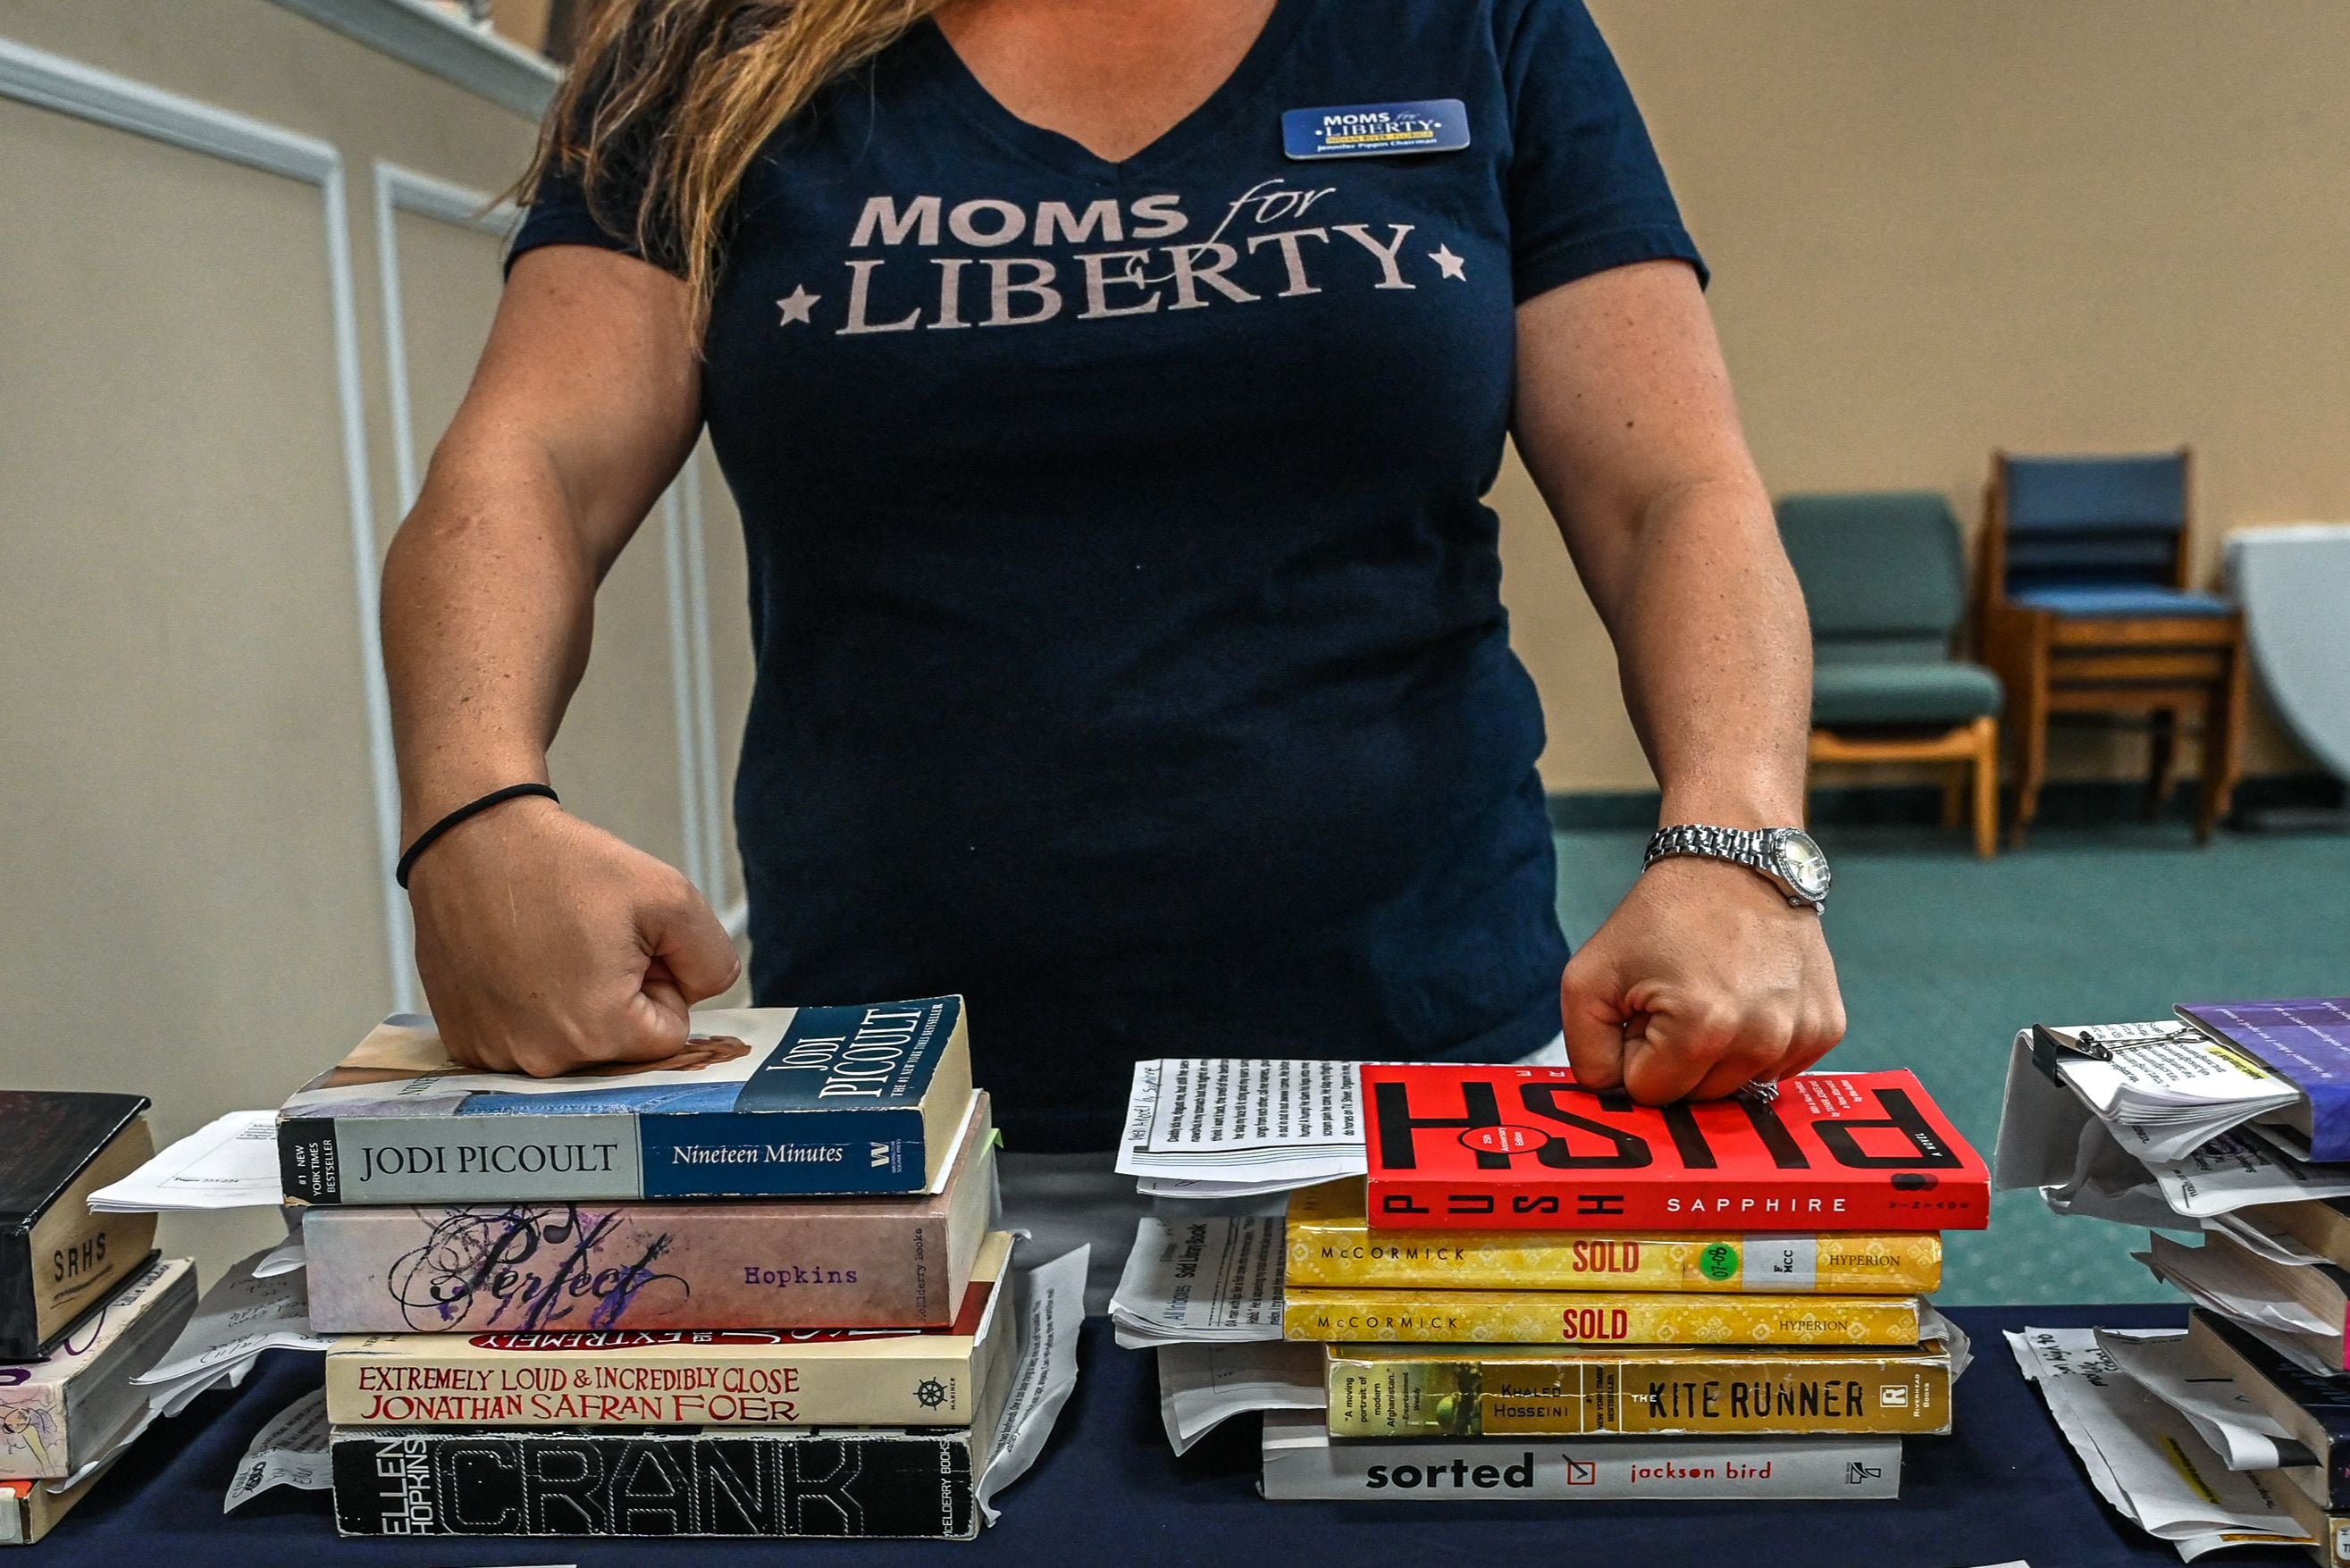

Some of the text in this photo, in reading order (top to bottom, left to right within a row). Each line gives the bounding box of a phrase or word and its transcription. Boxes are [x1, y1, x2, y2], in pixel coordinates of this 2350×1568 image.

[1323, 113, 1390, 126] MOMS
[1326, 120, 1433, 137] LIBERTY
[848, 178, 1337, 290] MOMS for
[835, 223, 1419, 336] LIBERTY
[921, 1003, 944, 1036] BESTSELLER
[766, 1036, 846, 1071] JODI
[818, 1009, 922, 1099] PICOULT
[908, 1050, 922, 1063] YORK
[914, 1036, 929, 1050] TIMES
[902, 1062, 915, 1076] NEW
[891, 1081, 906, 1097] THE
[672, 1143, 843, 1164] Nineteen Minutes
[1498, 1127, 1509, 1152] Anniversary
[1515, 1131, 1524, 1146] Edition
[1914, 1133, 1937, 1151] NOVEL
[295, 1145, 307, 1186] #1 NEW
[308, 1142, 322, 1197] YORK TIMES
[323, 1139, 337, 1194] BESTSELLER
[360, 1144, 618, 1182] JODI PICOULT
[1382, 1193, 1624, 1215] PUSH
[1666, 1196, 1848, 1213] SAPPHIRE
[54, 1232, 107, 1282] SRHS
[914, 1228, 924, 1262] Books
[1321, 1240, 1640, 1273] McCORMICK SOLD
[1783, 1249, 1793, 1273] MCC
[1829, 1255, 1901, 1267] HYPERION
[390, 1204, 690, 1330] Perfect
[744, 1266, 858, 1287] Hopkins
[1774, 1265, 1783, 1273] F
[1317, 1308, 1848, 1339] McCORMICK SOLD HYPERION
[358, 1366, 800, 1395] EXTREMELY LOUD & INCREDIBLY CLOSE
[1345, 1378, 1354, 1407] moving
[1913, 1372, 1921, 1418] RIVERHEAD
[361, 1393, 800, 1421] JONATHAN SAFRAN FOER
[1358, 1376, 1368, 1423] portrait of
[1372, 1383, 1381, 1416] modern
[1386, 1368, 1396, 1428] Afghanistan."
[1494, 1404, 1568, 1417] HOSSEINI
[1632, 1380, 1865, 1418] THE KITE RUNNER
[939, 1438, 952, 1474] BOOKS
[1365, 1452, 1772, 1488] sorted jackson bird
[375, 1437, 411, 1536] ELLEN
[404, 1438, 434, 1536] HOPKINS
[435, 1438, 865, 1536] CRANK
